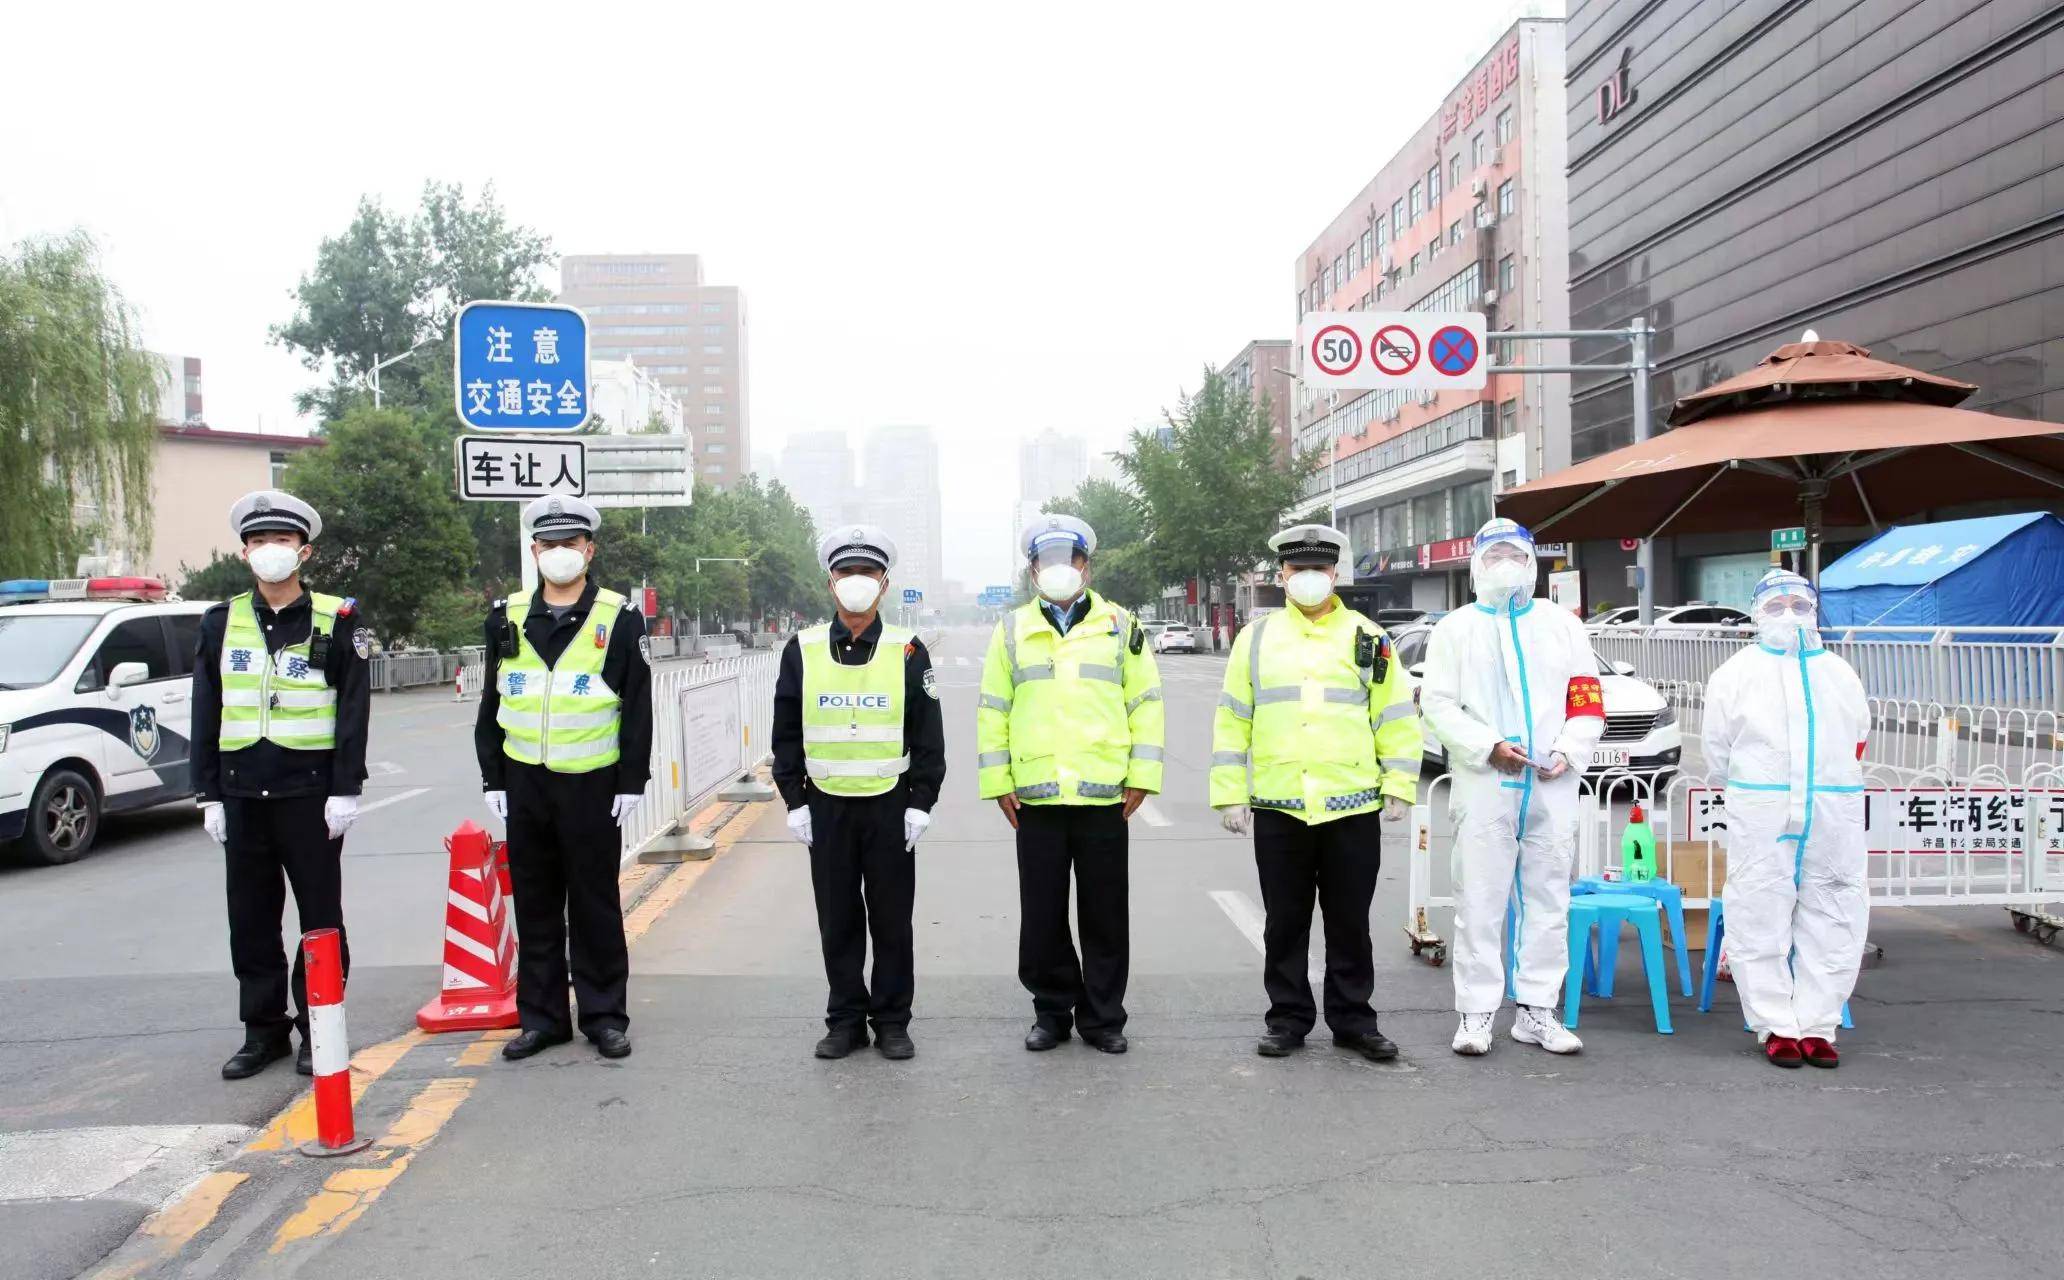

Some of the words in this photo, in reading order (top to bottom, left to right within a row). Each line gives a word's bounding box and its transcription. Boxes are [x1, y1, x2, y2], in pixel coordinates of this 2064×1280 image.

[486, 326, 560, 364] 注意
[1322, 338, 1353, 363] 50
[466, 378, 582, 416] 交通安全
[471, 451, 580, 489] 车让人
[230, 649, 310, 680] 警察
[507, 671, 591, 696] 警察
[819, 695, 888, 708] POLICE
